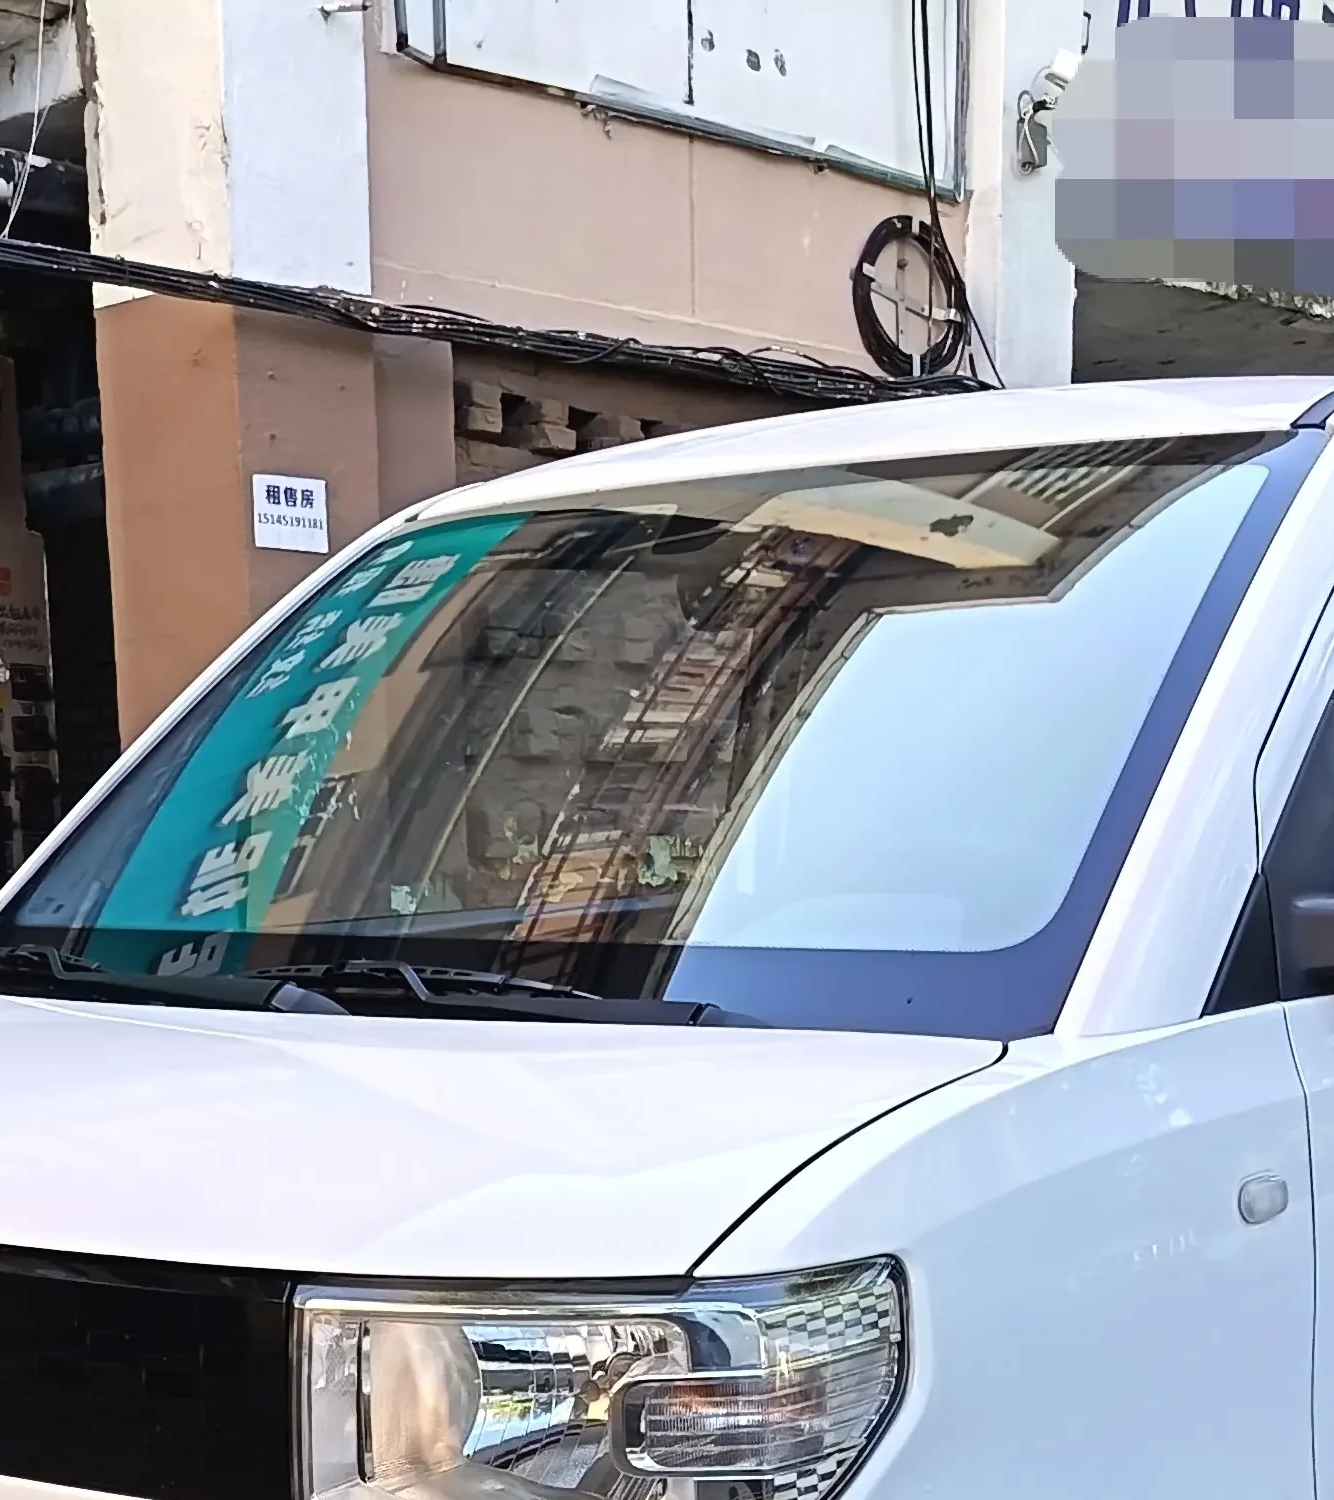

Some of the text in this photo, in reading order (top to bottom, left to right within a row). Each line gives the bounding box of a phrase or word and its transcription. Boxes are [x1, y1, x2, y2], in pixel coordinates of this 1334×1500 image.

[265, 484, 315, 509] 租售房
[258, 512, 323, 530] 15145191181
